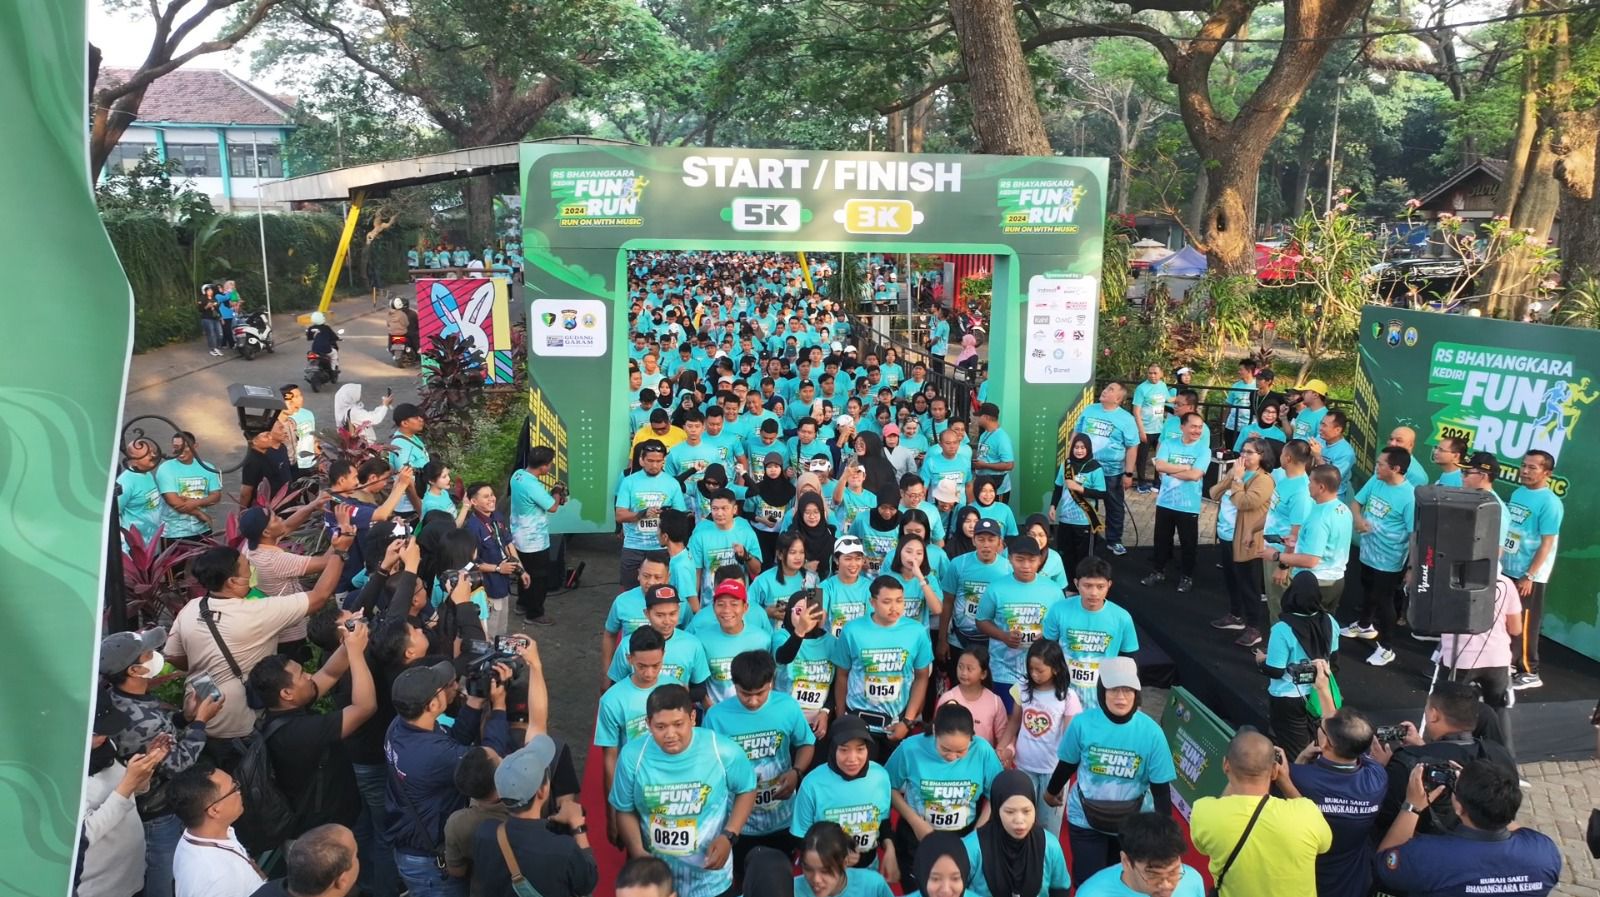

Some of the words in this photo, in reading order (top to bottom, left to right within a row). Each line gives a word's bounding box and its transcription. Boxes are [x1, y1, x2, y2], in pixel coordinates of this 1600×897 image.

[552, 171, 564, 179] RS
[567, 169, 635, 178] BHAYANGKARA
[682, 156, 809, 190] START
[834, 160, 961, 192] FINISH
[574, 178, 624, 197] FUN
[1013, 180, 1075, 188] BHAYANGKARA
[1019, 188, 1064, 206] FUN
[587, 198, 637, 215] RUN
[744, 204, 788, 226] 5K
[857, 206, 900, 228] 3K
[1029, 206, 1074, 223] RUN
[1435, 348, 1453, 363] RS
[1455, 351, 1573, 377] BHAYANGKARA
[1432, 367, 1465, 381] KEDIRI
[1461, 371, 1547, 417] FUN
[1474, 415, 1567, 468] RUN
[1018, 616, 1042, 625] RUN
[1076, 635, 1101, 644] FUN
[1082, 643, 1107, 653] RUN
[872, 653, 896, 663] FUN
[878, 662, 903, 672] RUN
[1072, 669, 1095, 681] 1651
[796, 690, 821, 704] 1482
[869, 684, 895, 697] 0154
[743, 736, 771, 750] FUN
[751, 746, 777, 760] RUN
[1100, 753, 1128, 767] FUN
[1181, 740, 1201, 767] FUN
[1106, 765, 1136, 779] RUN
[1180, 757, 1201, 783] RUN
[660, 788, 692, 804] FUN
[934, 786, 964, 799] FUN
[667, 801, 702, 815] RUN
[1324, 797, 1348, 805] RUMAH
[839, 811, 867, 826] FUN
[930, 812, 959, 826] 1587
[654, 828, 689, 846] 0829
[1507, 875, 1528, 883] SAKIT
[1465, 884, 1518, 893] BHAYANGKARA
